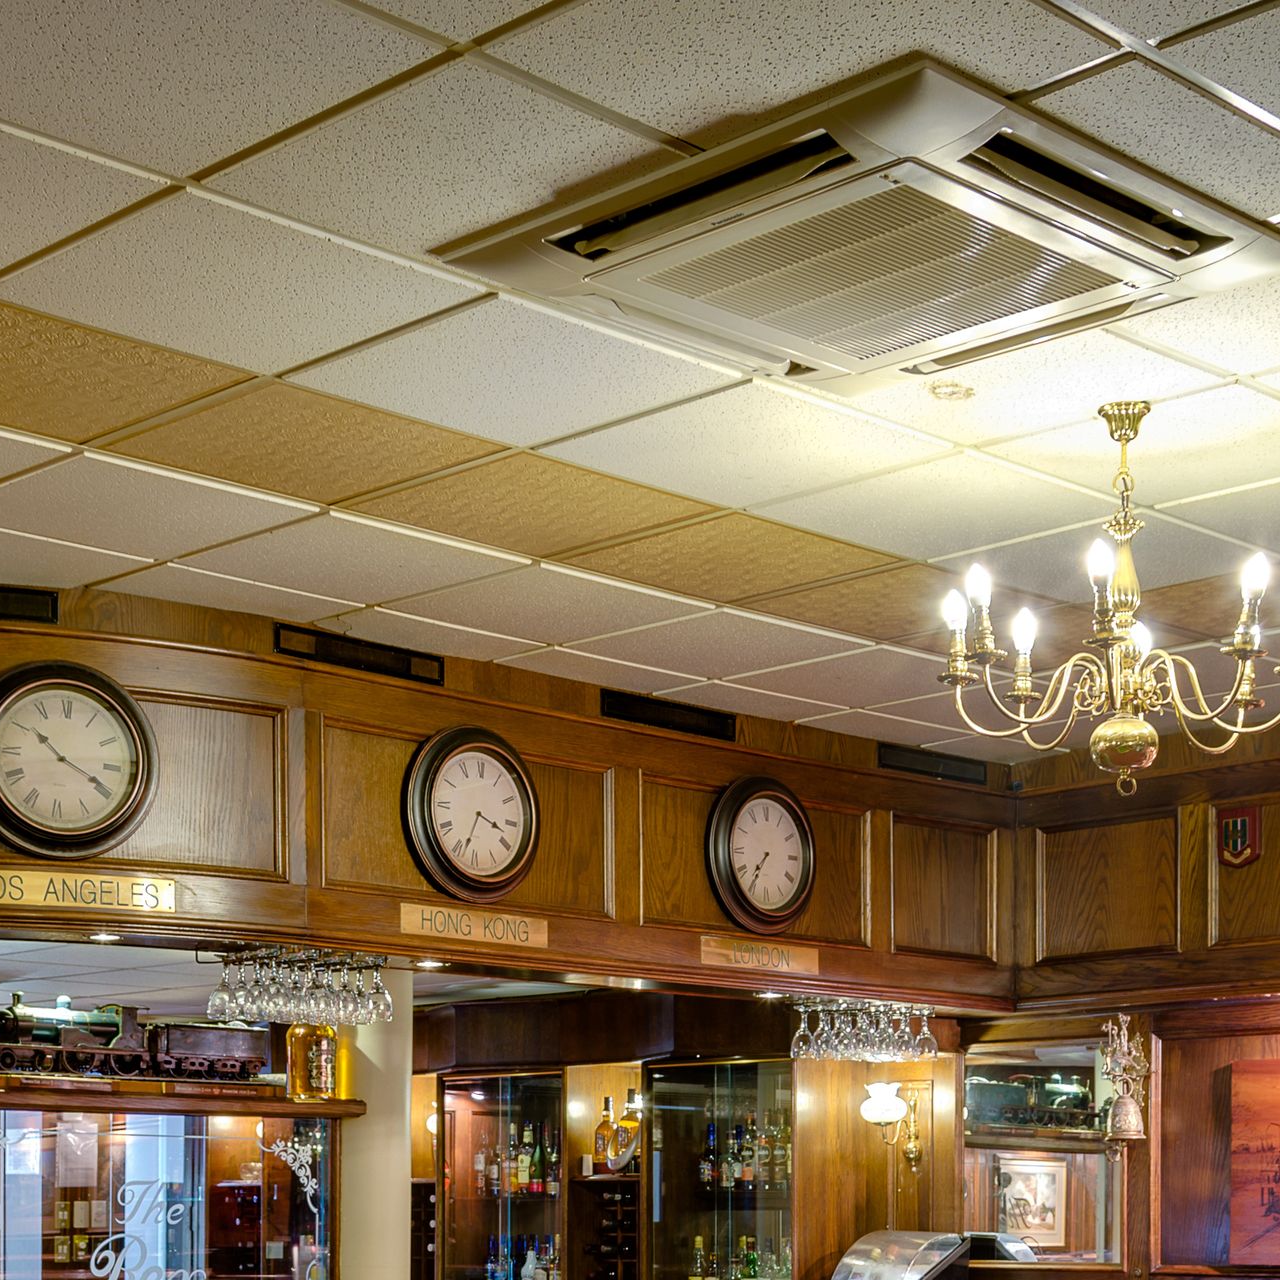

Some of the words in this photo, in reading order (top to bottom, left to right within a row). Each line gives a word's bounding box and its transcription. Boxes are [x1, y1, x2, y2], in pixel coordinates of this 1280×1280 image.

[43, 878, 159, 909] ANGELES
[421, 909, 471, 937] HONG
[483, 917, 529, 943] KONG
[732, 942, 790, 969] LONDON
[114, 1178, 185, 1226] The
